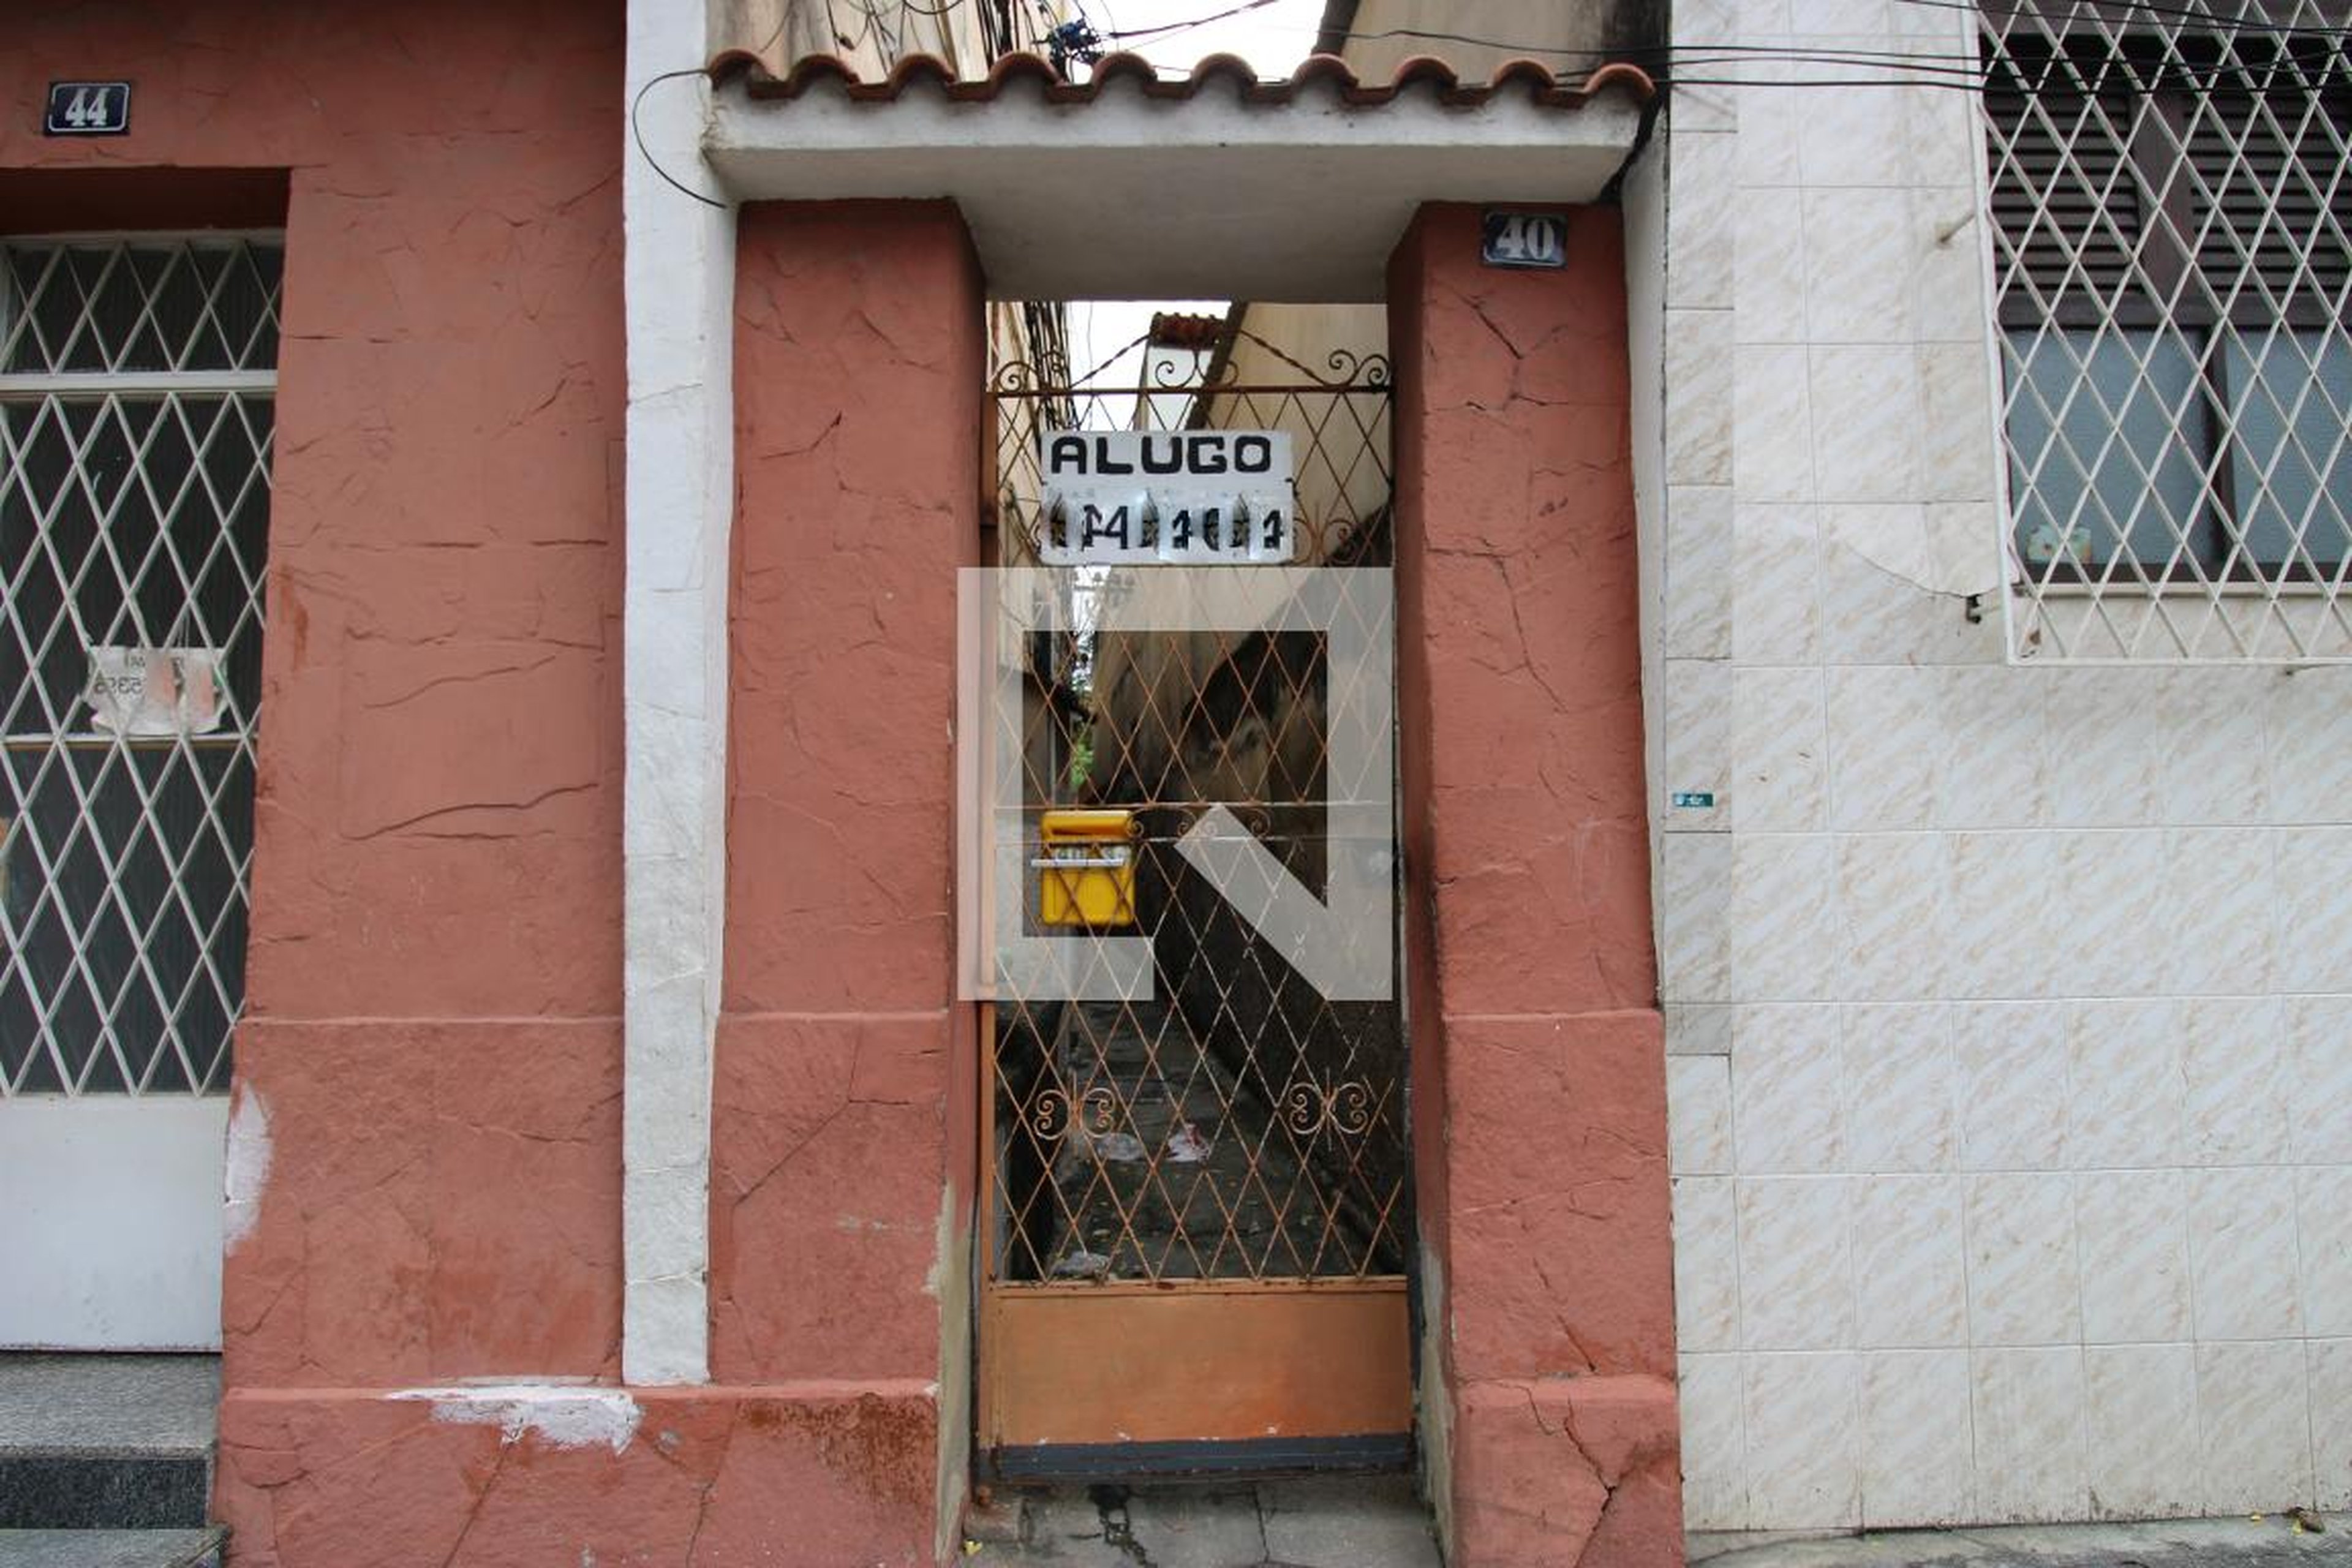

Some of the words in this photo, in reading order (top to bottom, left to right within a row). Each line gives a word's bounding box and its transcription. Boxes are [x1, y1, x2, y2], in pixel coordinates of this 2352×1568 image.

[65, 88, 110, 126] 44
[1496, 216, 1555, 260] 40
[1050, 436, 1272, 474] ALUGO
